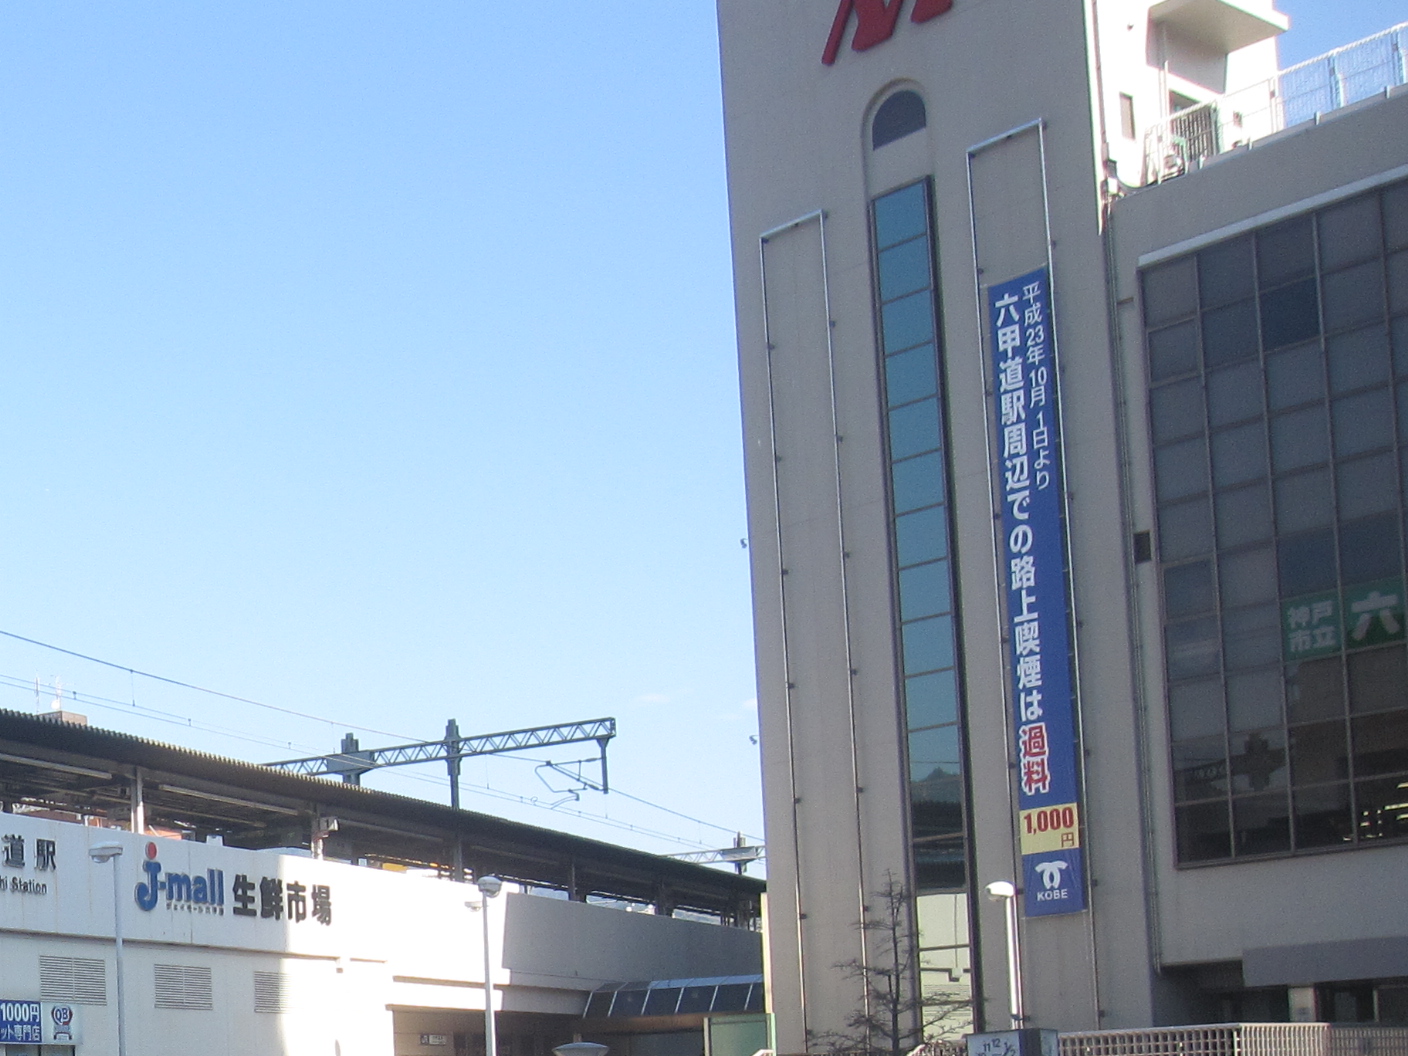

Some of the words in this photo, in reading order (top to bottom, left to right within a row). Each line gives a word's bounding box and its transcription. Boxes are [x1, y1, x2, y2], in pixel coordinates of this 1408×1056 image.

[1022, 281, 1051, 490] 平成23年10月1日より
[994, 292, 1050, 795] 六甲道駅周辺での路上喫煙は過料
[1350, 590, 1401, 641] 六
[1288, 626, 1337, 652] 市立
[1023, 807, 1074, 835] 1,000
[1061, 832, 1075, 848] 円
[10, 876, 48, 895] Station
[1037, 889, 1068, 902] KOBE
[232, 874, 332, 926] 生鮮市場
